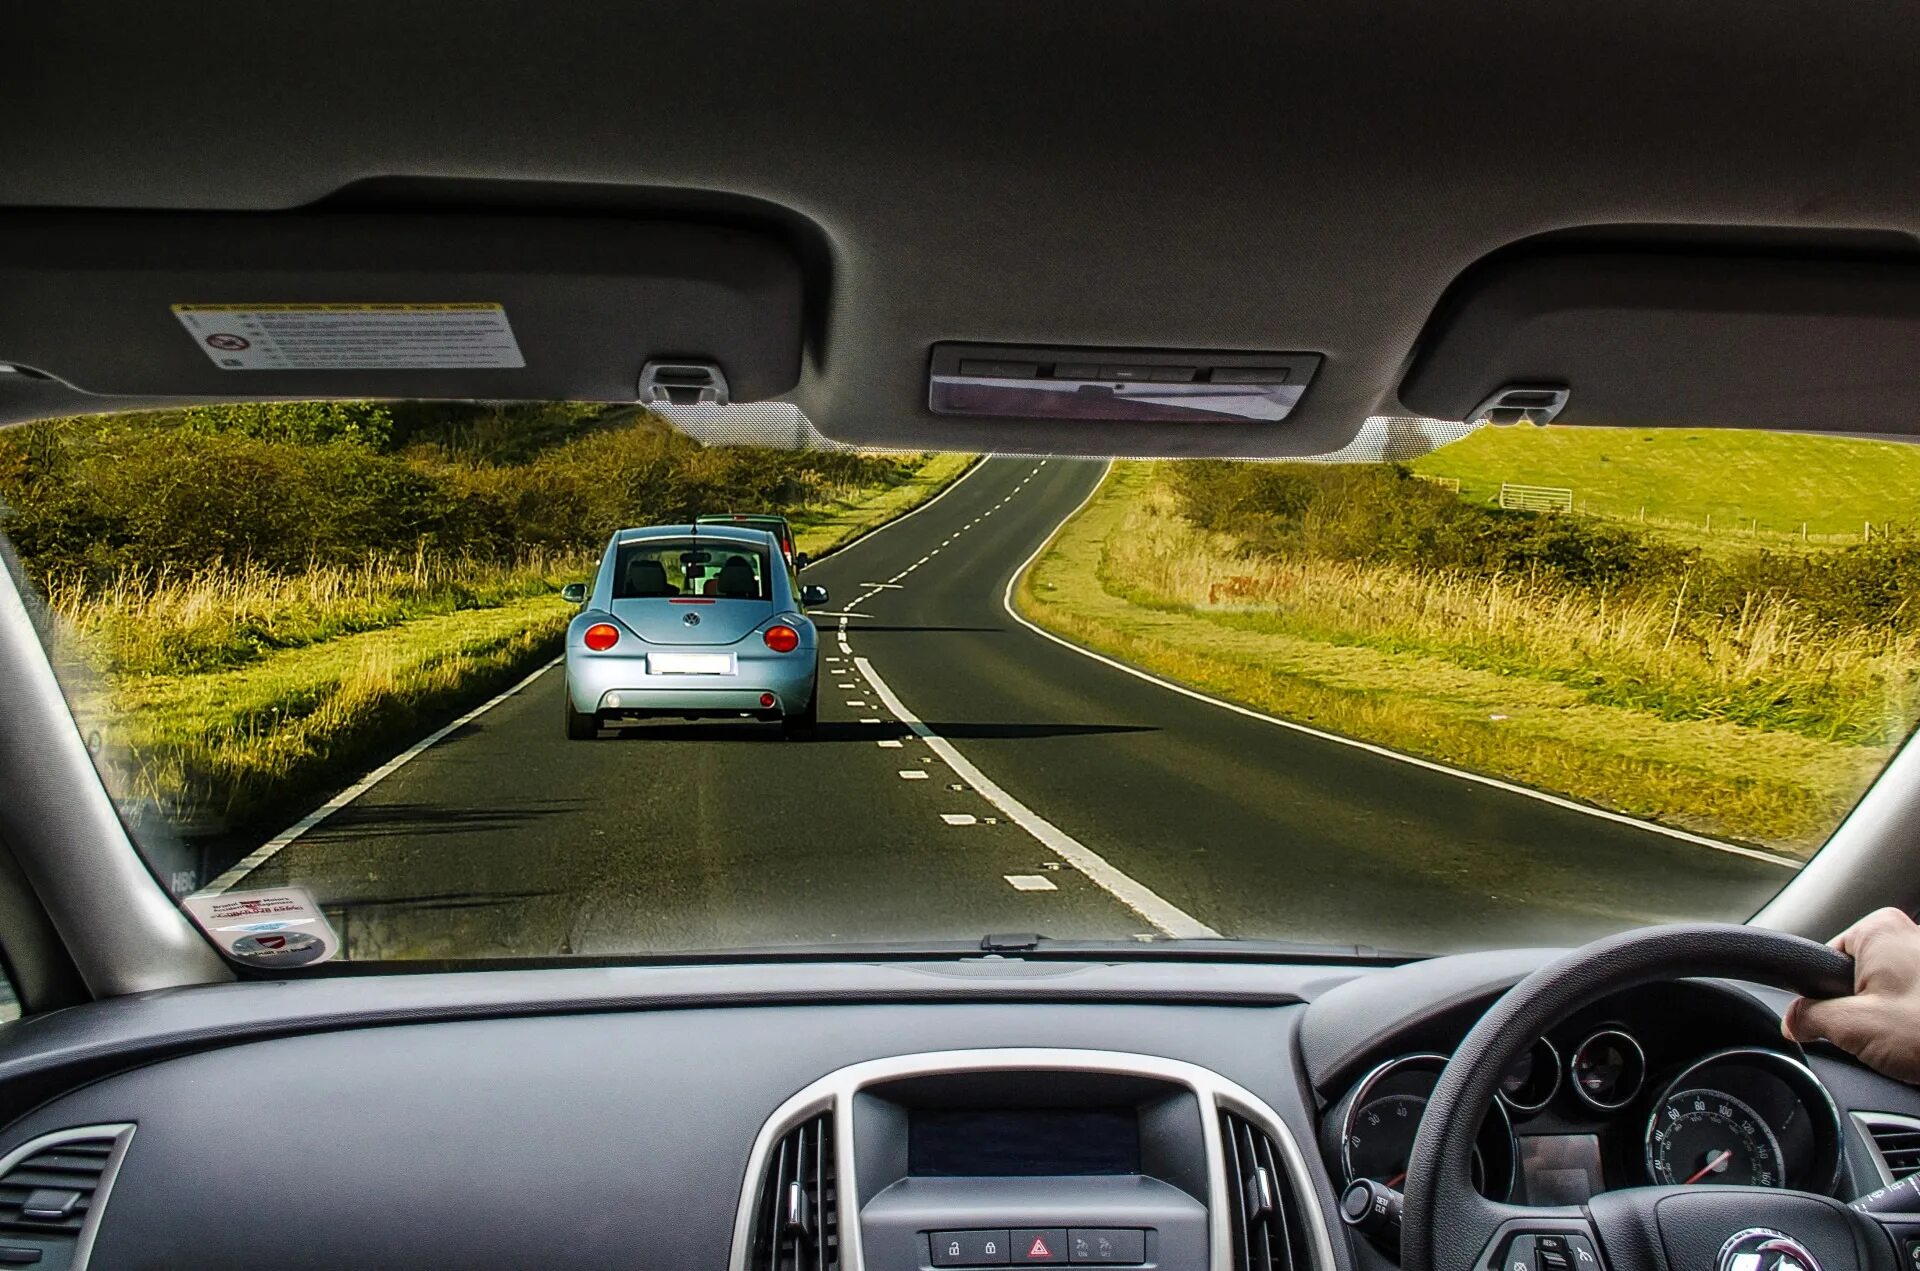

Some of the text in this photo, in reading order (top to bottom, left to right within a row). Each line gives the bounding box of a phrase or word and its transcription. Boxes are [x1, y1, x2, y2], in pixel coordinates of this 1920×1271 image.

[1396, 1107, 1408, 1117] 40
[1694, 1101, 1706, 1111] 80
[1719, 1104, 1733, 1118] 100
[1368, 1114, 1381, 1126] 30
[1667, 1108, 1680, 1120] 60
[1742, 1120, 1755, 1135] 120
[1761, 1172, 1772, 1186] 160
